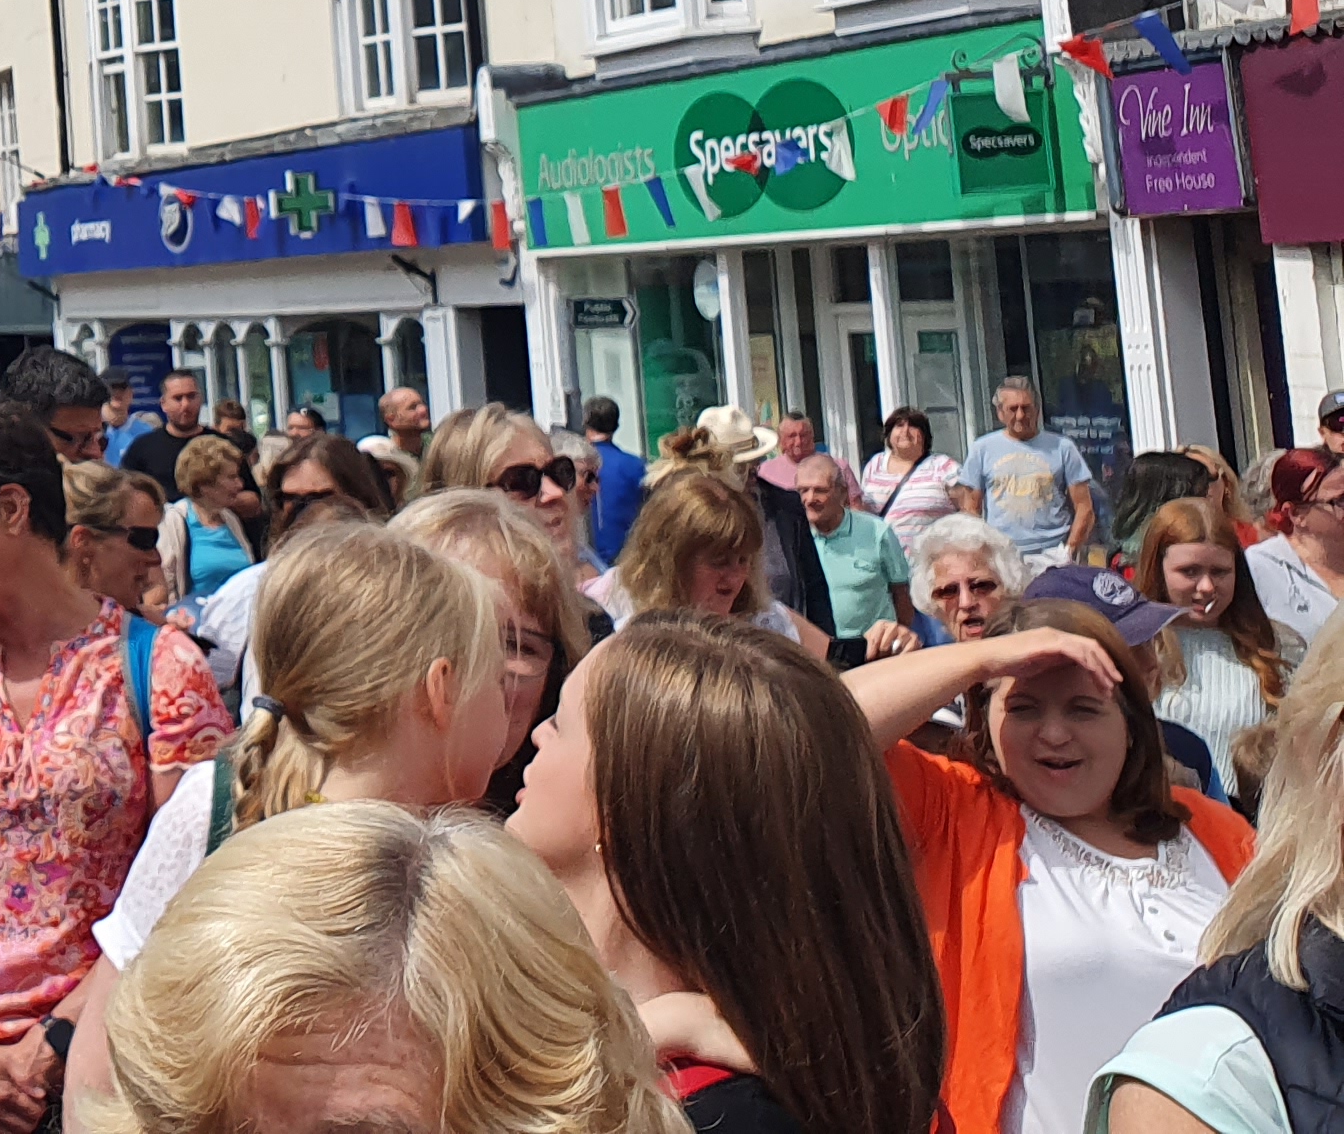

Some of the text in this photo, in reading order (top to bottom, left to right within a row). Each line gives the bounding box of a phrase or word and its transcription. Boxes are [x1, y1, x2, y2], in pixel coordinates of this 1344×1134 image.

[1119, 82, 1214, 142] Vine Inn
[689, 120, 838, 186] Specsavers
[968, 132, 1036, 153] Specsavers
[538, 143, 656, 191] Audiologists
[1174, 171, 1216, 191] House
[70, 218, 112, 246] pharmacy
